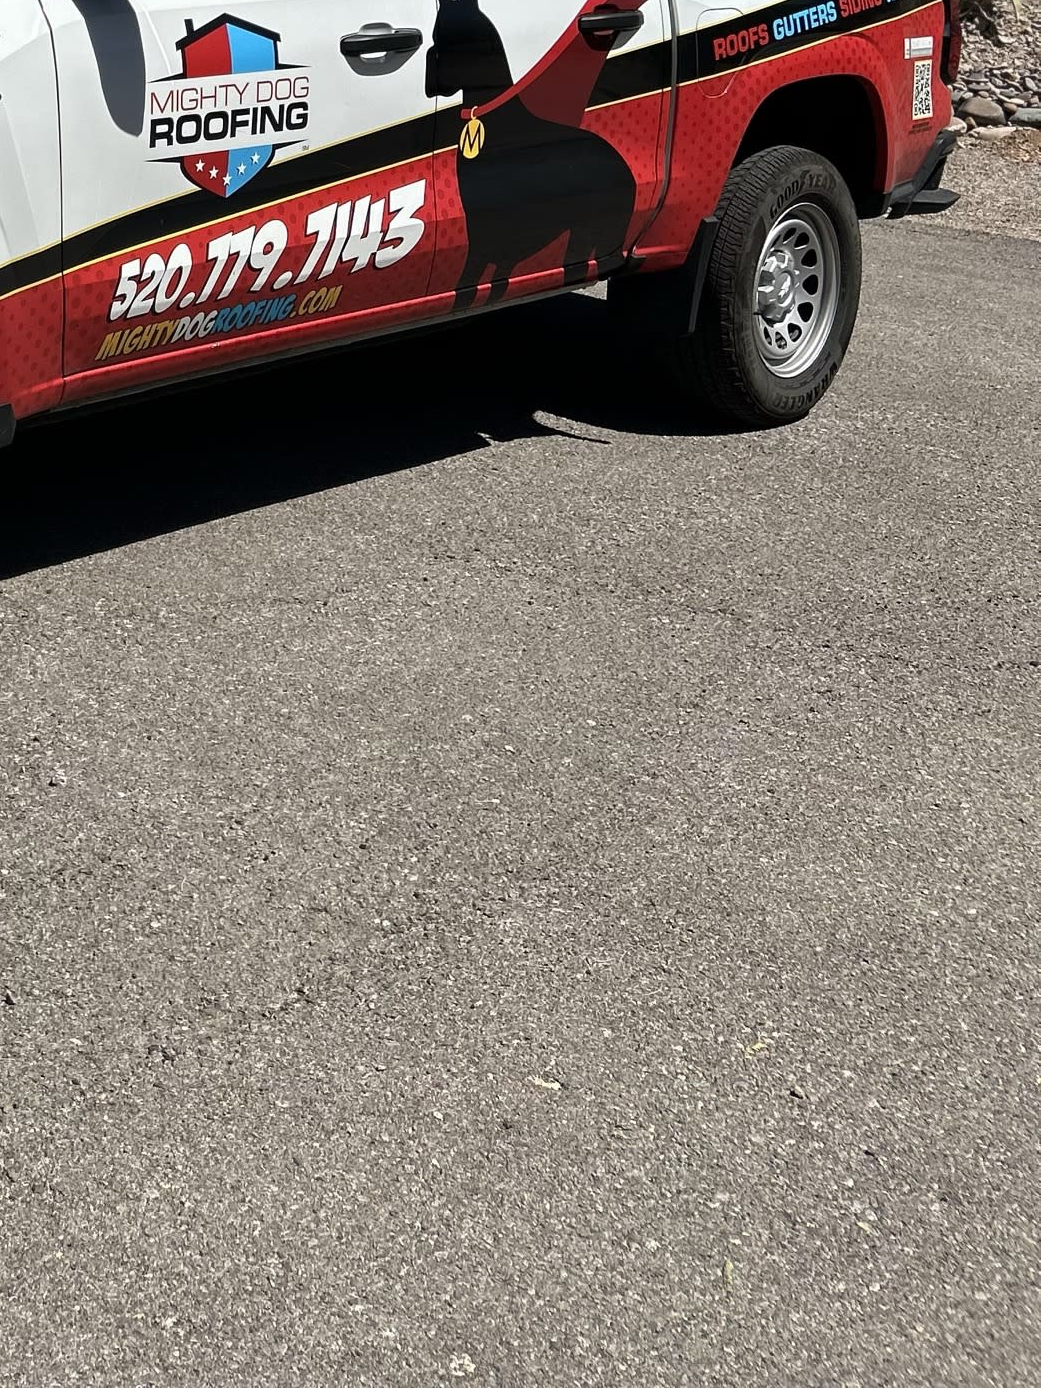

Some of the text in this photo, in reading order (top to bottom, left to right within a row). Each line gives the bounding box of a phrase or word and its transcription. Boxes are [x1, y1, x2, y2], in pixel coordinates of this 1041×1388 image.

[713, 23, 770, 61] ROOFS
[772, 0, 837, 42] GUTTERS
[149, 100, 310, 149] ROOFING
[150, 75, 310, 115] MIGHTY DOG
[108, 178, 426, 323] 520.779.7143
[94, 285, 343, 361] MIGHTYDOGROOFING.COM
